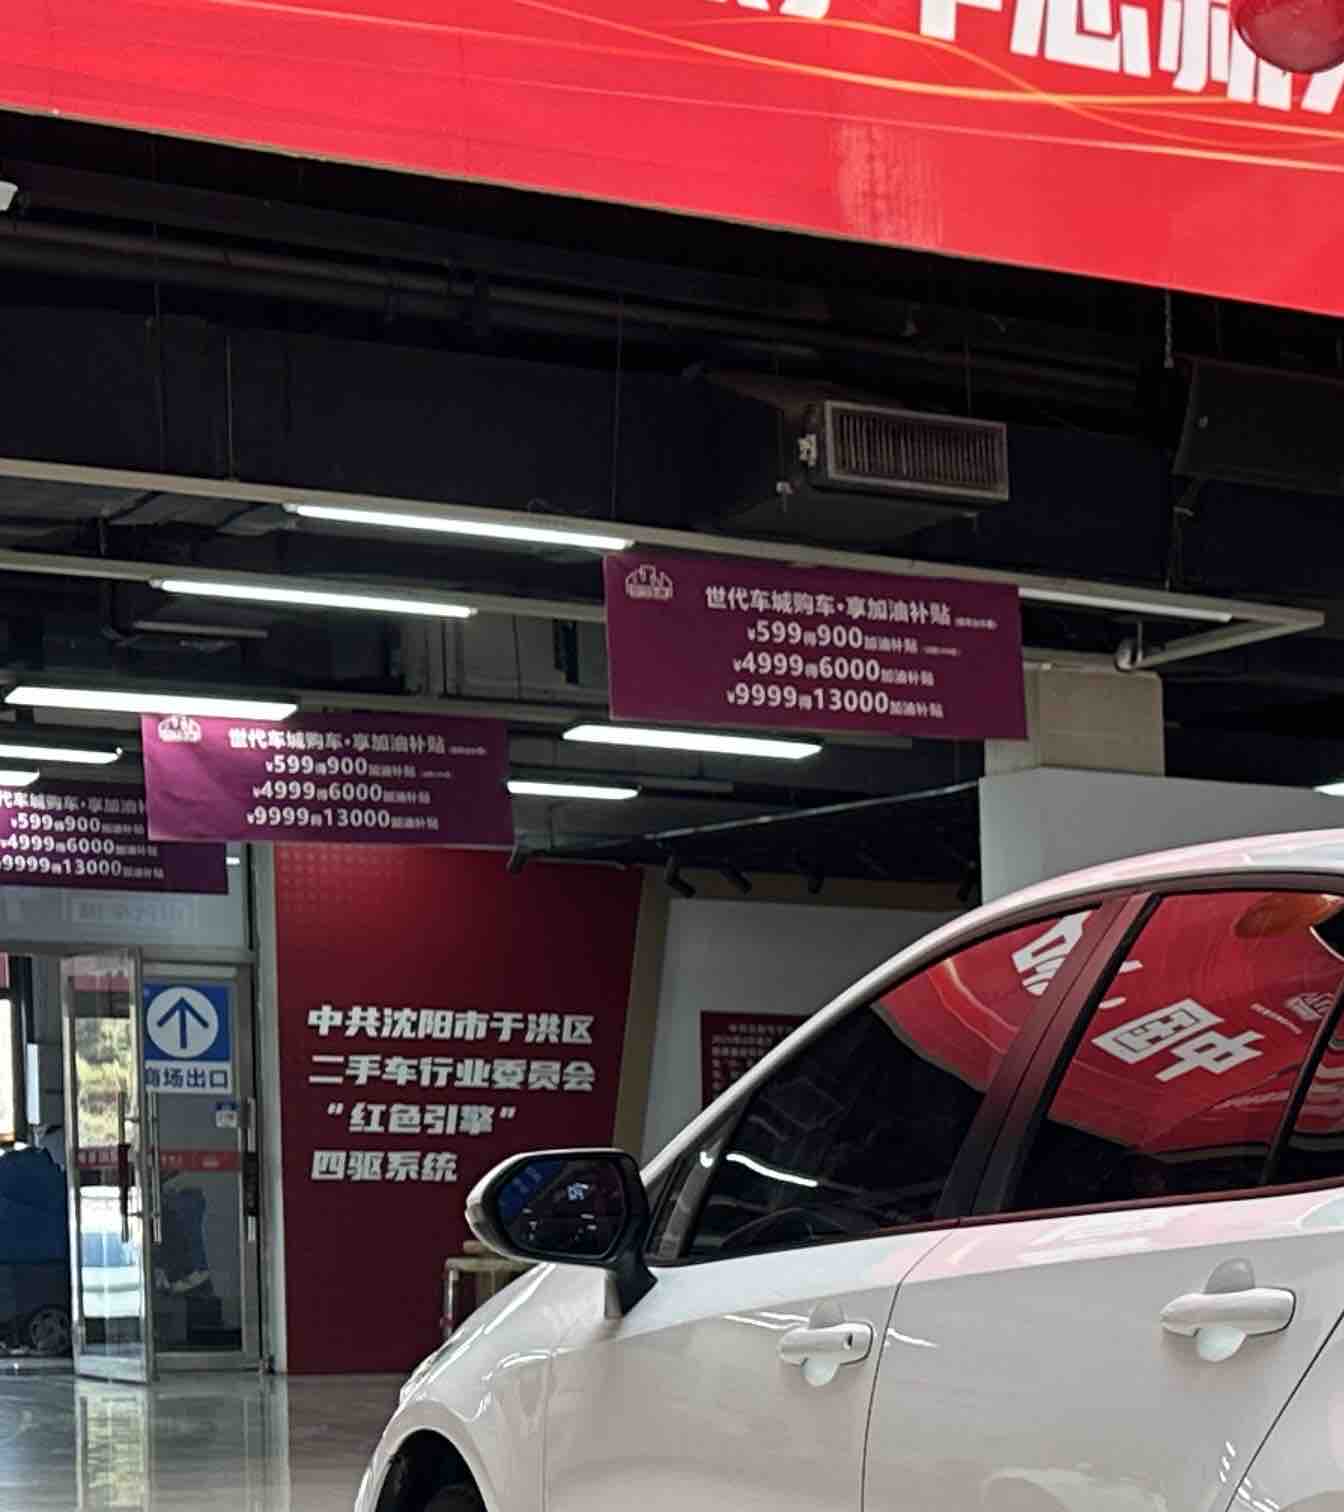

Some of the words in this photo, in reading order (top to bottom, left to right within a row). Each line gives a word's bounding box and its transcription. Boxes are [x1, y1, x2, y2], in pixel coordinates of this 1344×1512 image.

[307, 1005, 594, 1044] 中共沈阳市于洪区
[309, 1054, 596, 1091] 二手车行业委员会
[311, 1150, 457, 1181] 四驱系统
